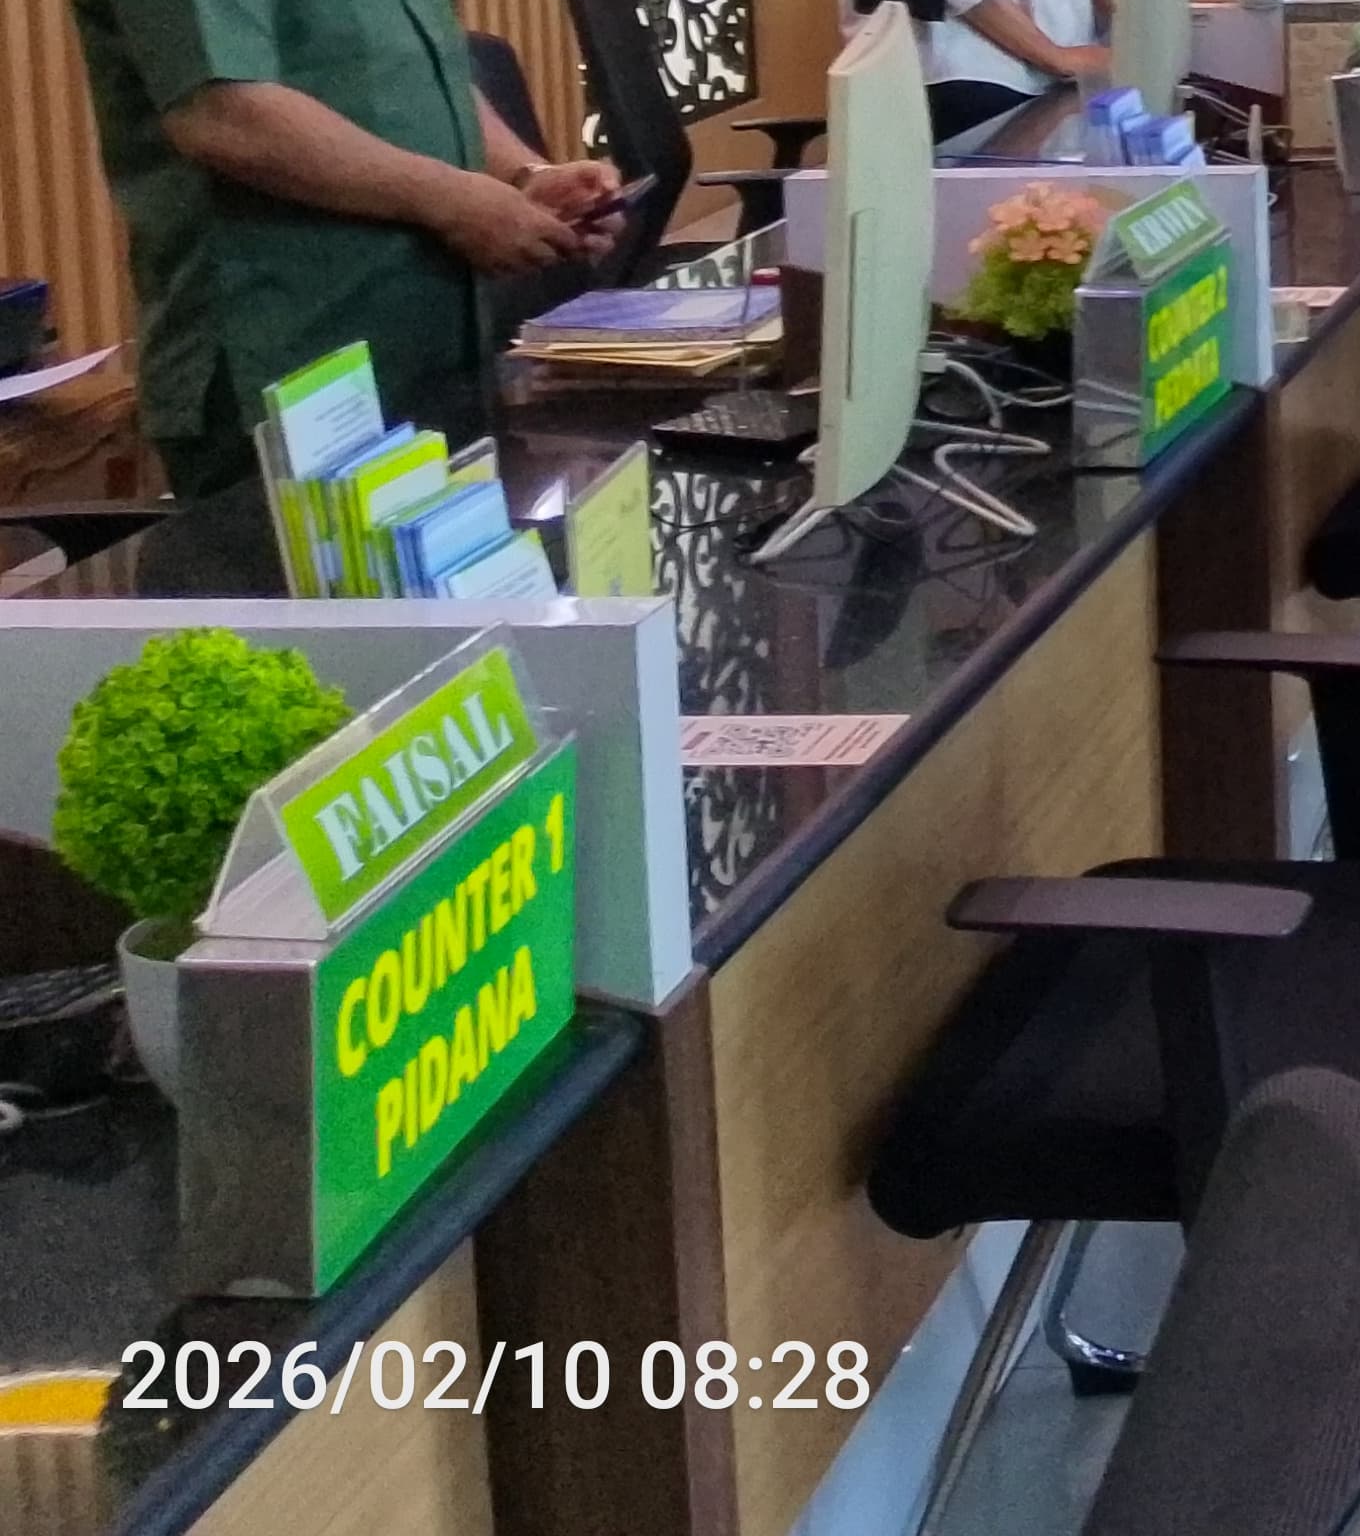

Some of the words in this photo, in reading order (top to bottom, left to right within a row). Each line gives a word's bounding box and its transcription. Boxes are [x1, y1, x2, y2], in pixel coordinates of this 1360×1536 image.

[313, 691, 514, 881] FAISAL
[336, 824, 538, 1078] COUNTER
[544, 792, 565, 875] 1
[376, 945, 538, 1179] PIDANA
